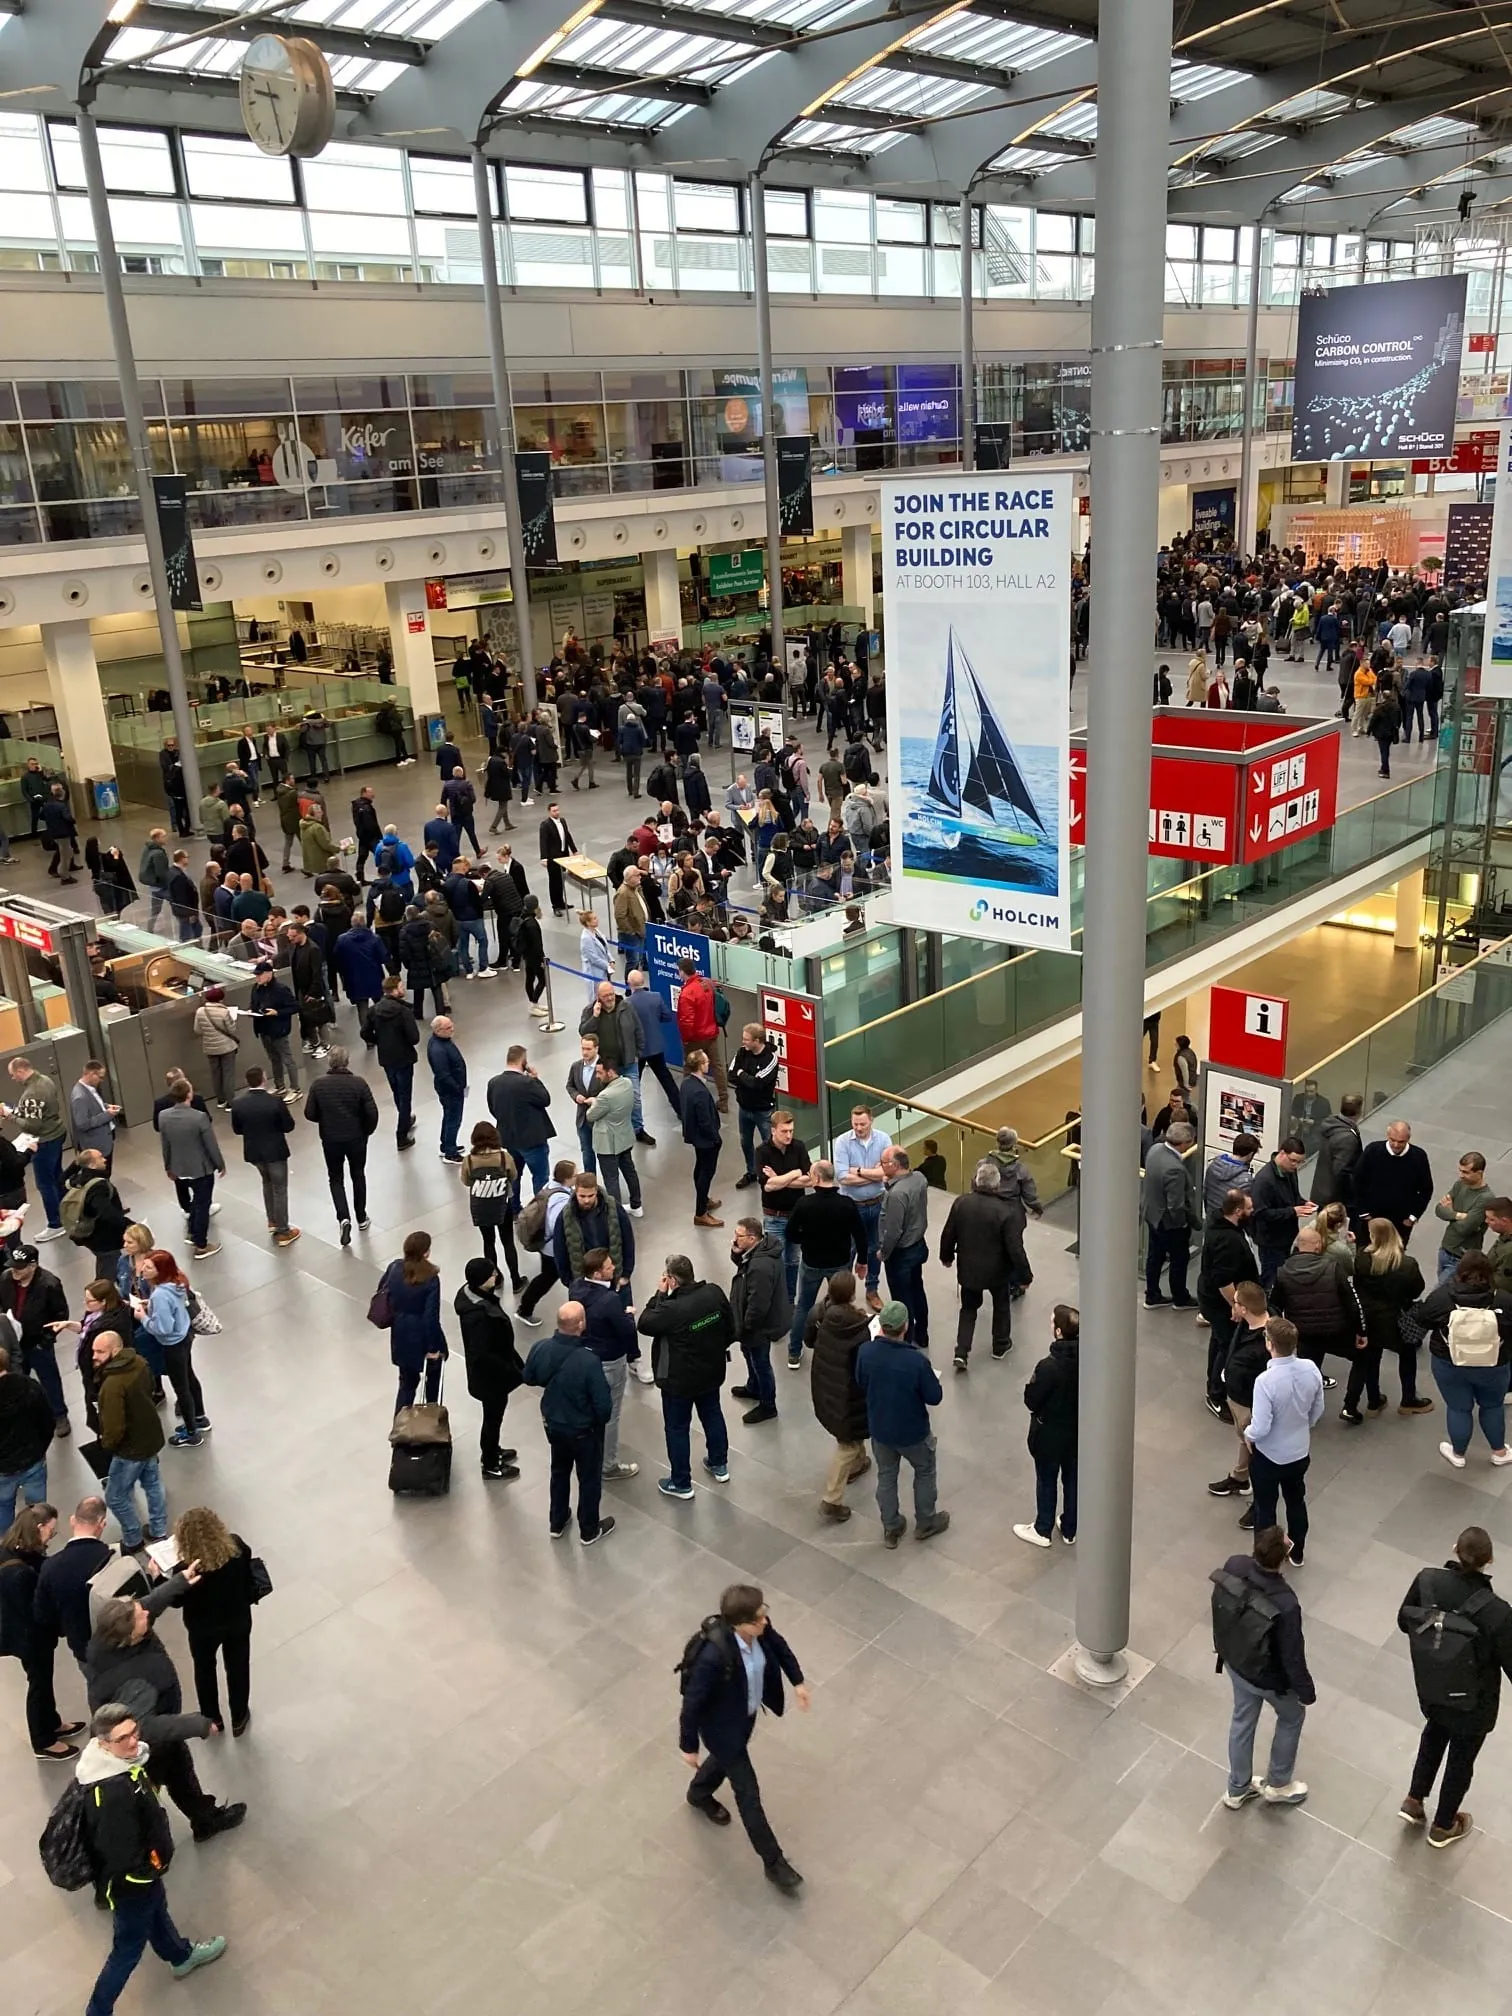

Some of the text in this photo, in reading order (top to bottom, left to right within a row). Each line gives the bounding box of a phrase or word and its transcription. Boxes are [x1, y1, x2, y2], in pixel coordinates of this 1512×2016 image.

[1315, 340, 1414, 357] CARBON CONTROL
[1316, 334, 1351, 345] Schüco
[1363, 356, 1370, 364] in
[341, 423, 397, 456] Käfer
[1398, 431, 1445, 443] SCHÜCO
[388, 452, 445, 471] am See
[894, 489, 1054, 514] JOIN THE RACE
[895, 518, 1050, 541] FOR CIRCULAR
[896, 547, 993, 567] BUILDING
[896, 573, 1057, 591] AT BOOTH 103, HALL A2
[1273, 771, 1287, 786] LIFT
[917, 813, 943, 826] HOLCIM
[1211, 819, 1224, 827] WC
[993, 908, 1059, 929] HOLCIM
[654, 934, 701, 962] Tickets
[471, 1177, 508, 1198] NIKE
